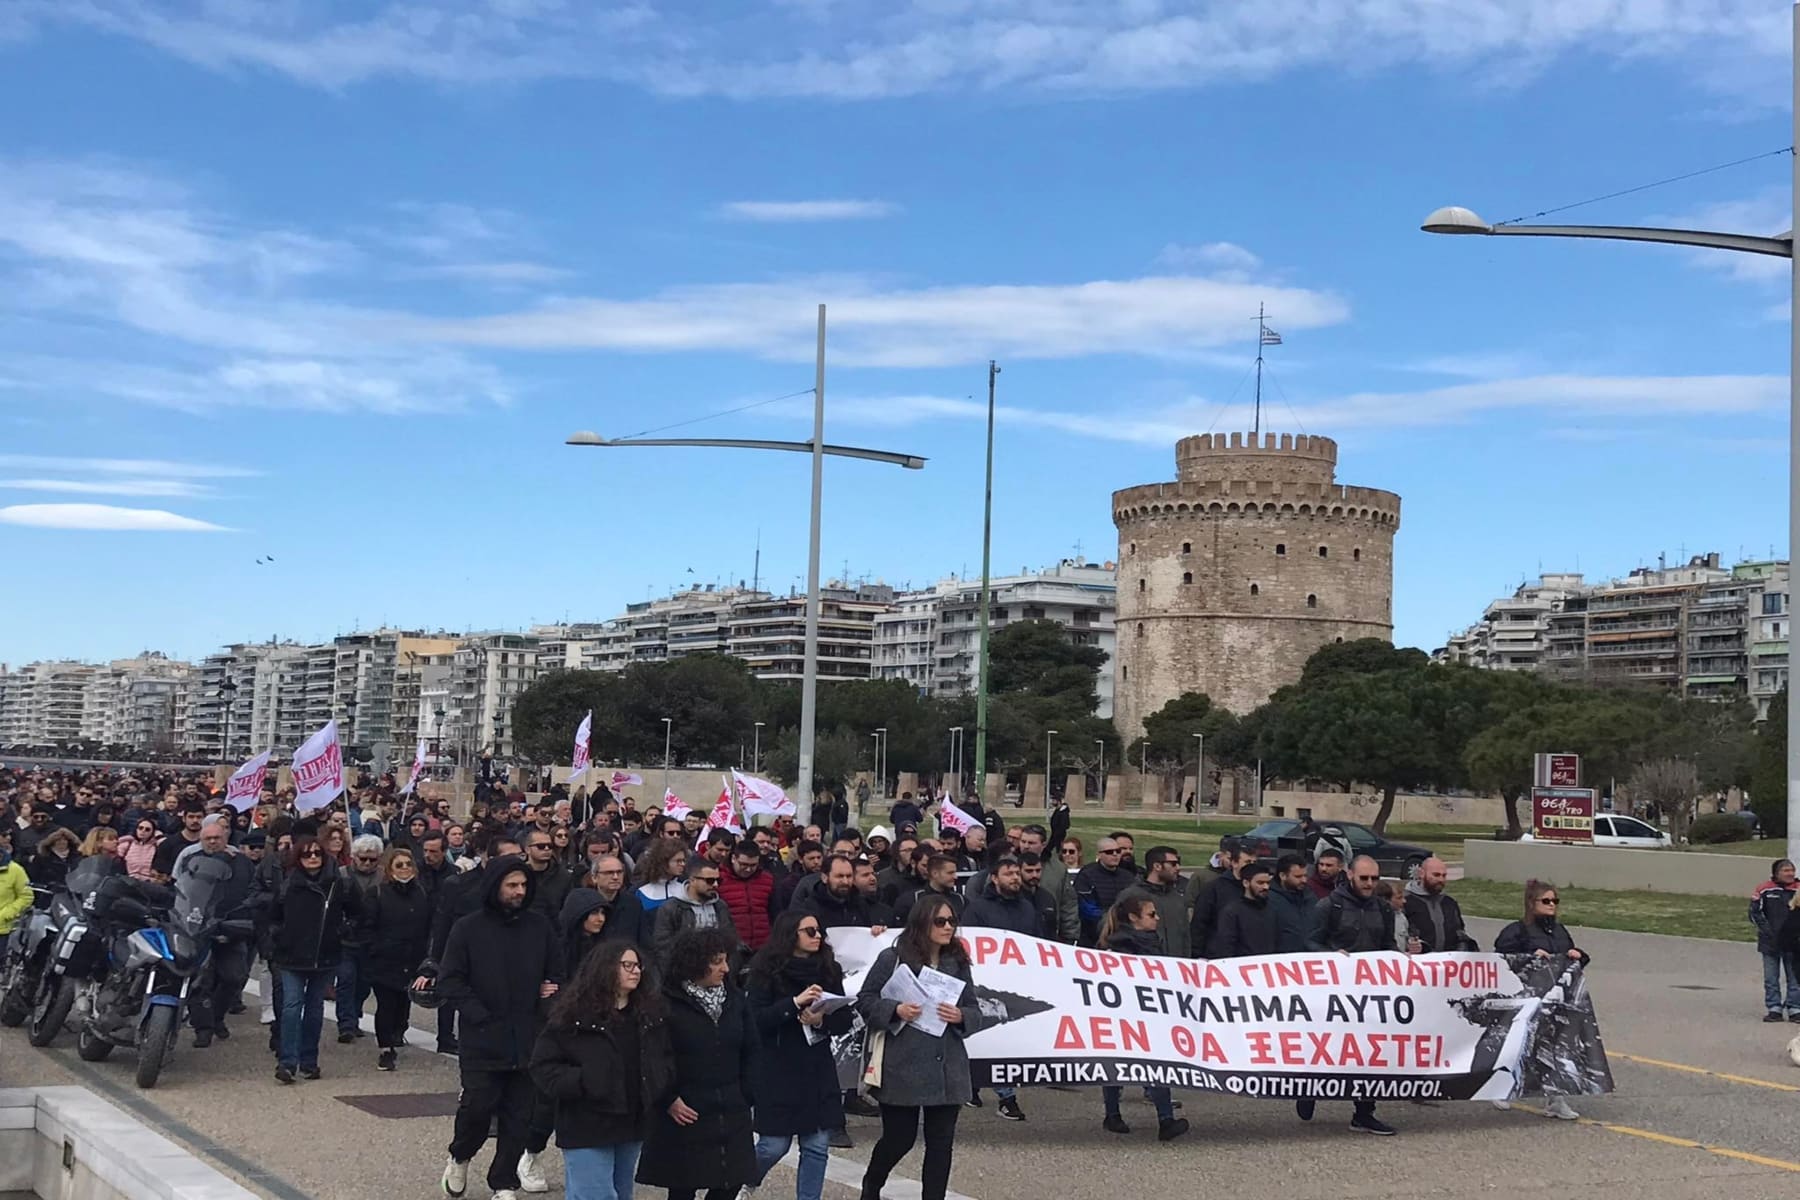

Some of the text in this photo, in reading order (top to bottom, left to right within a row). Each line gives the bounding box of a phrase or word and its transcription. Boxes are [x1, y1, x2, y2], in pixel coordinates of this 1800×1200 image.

[1037, 943, 1064, 968] Η
[1075, 950, 1169, 981] ΟΡΓΗ
[1178, 961, 1231, 989] ΝΑ
[1238, 959, 1341, 988] ΓΙΝΕΙ
[1355, 959, 1498, 989] ΑΝΑΤΡΟΠΗ
[1072, 978, 1415, 1025] ΤΟ ΕΓΚΛΗΜΑ ΑΥΤΟ
[1054, 1016, 1451, 1068] ΔΕΝ ΘΑ ΞΕΧΑΣΤΕΙ.
[990, 1062, 1443, 1098] ΕΡΓΑΤΙΚΑ ΣΩΜΑΤΕΙΑ ΦΟΙΤΗΤΙΚΟΙ ΣΥΛΛΟΓΟΙ.
